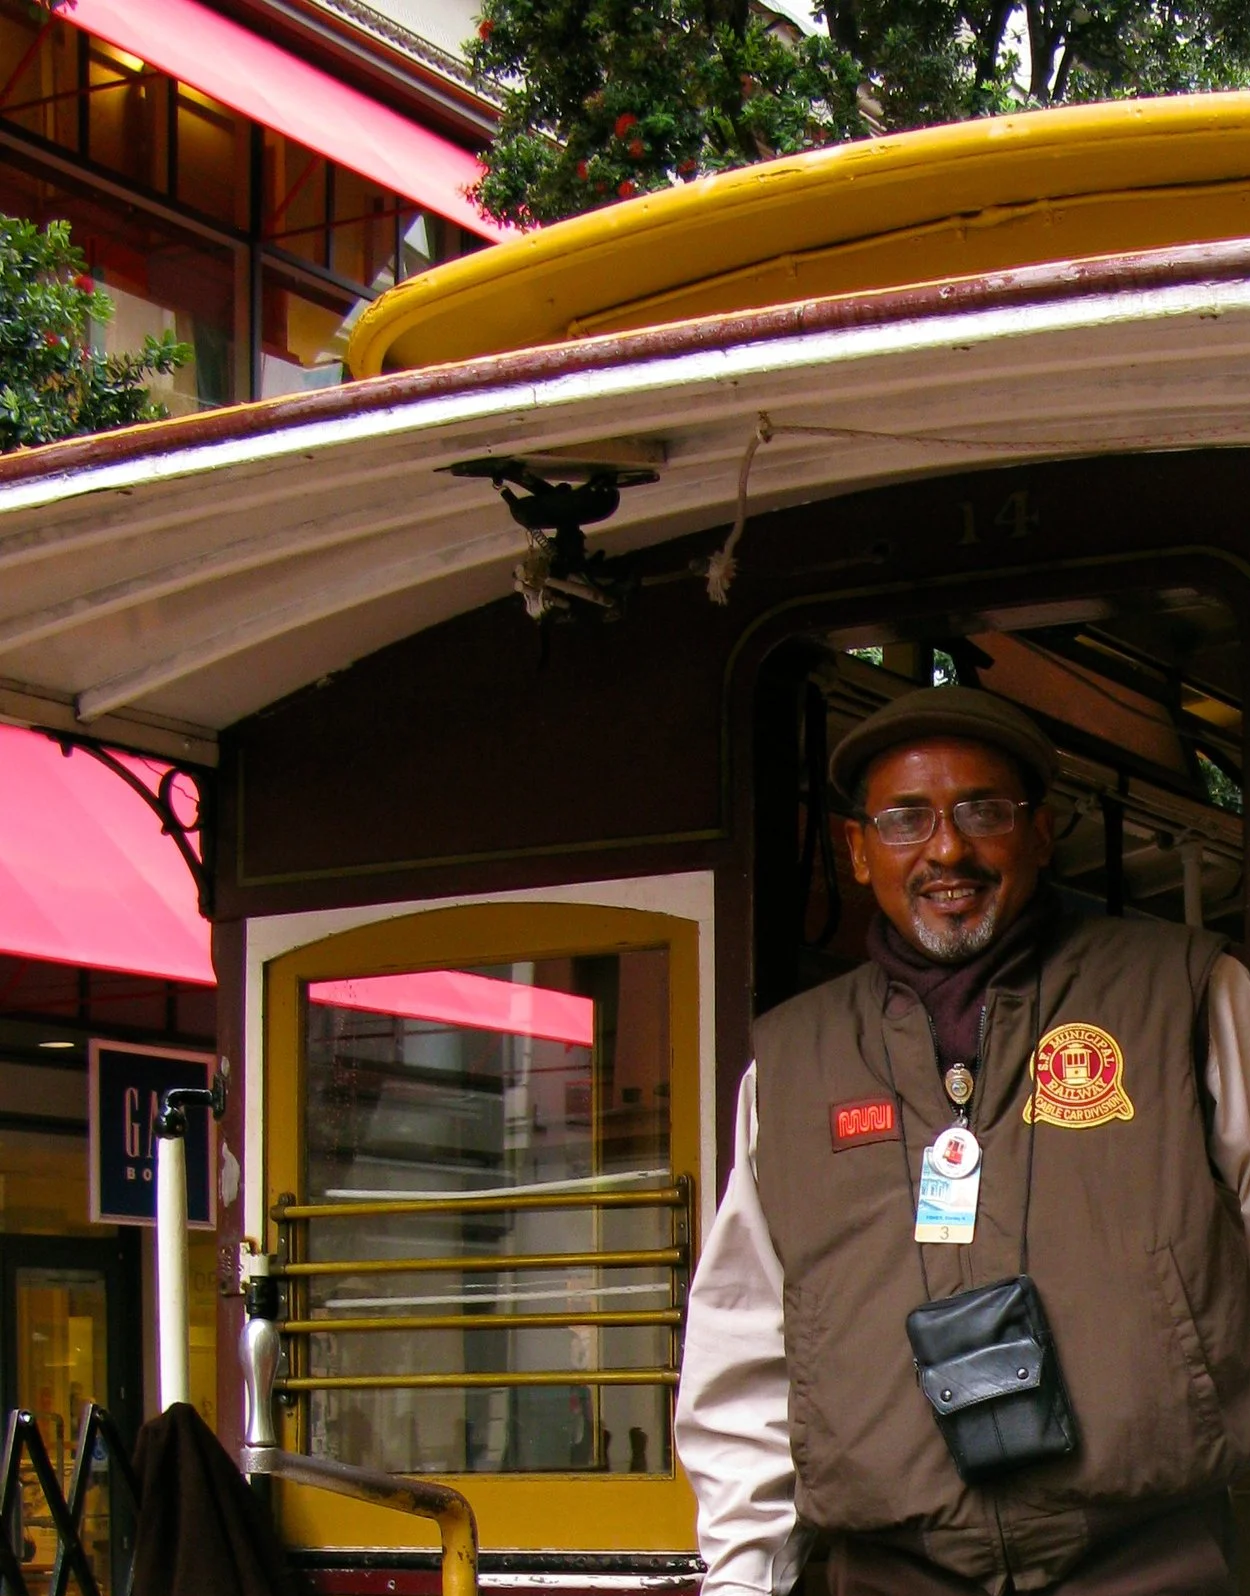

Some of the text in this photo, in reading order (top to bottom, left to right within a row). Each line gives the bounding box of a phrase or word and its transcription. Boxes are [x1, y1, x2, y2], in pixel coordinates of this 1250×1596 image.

[955, 490, 1040, 546] 14
[1048, 1029, 1116, 1068] MUNICIPAL
[1045, 1076, 1108, 1101] RAILWAY
[1035, 1093, 1122, 1121] CABLE CAR DIVISION
